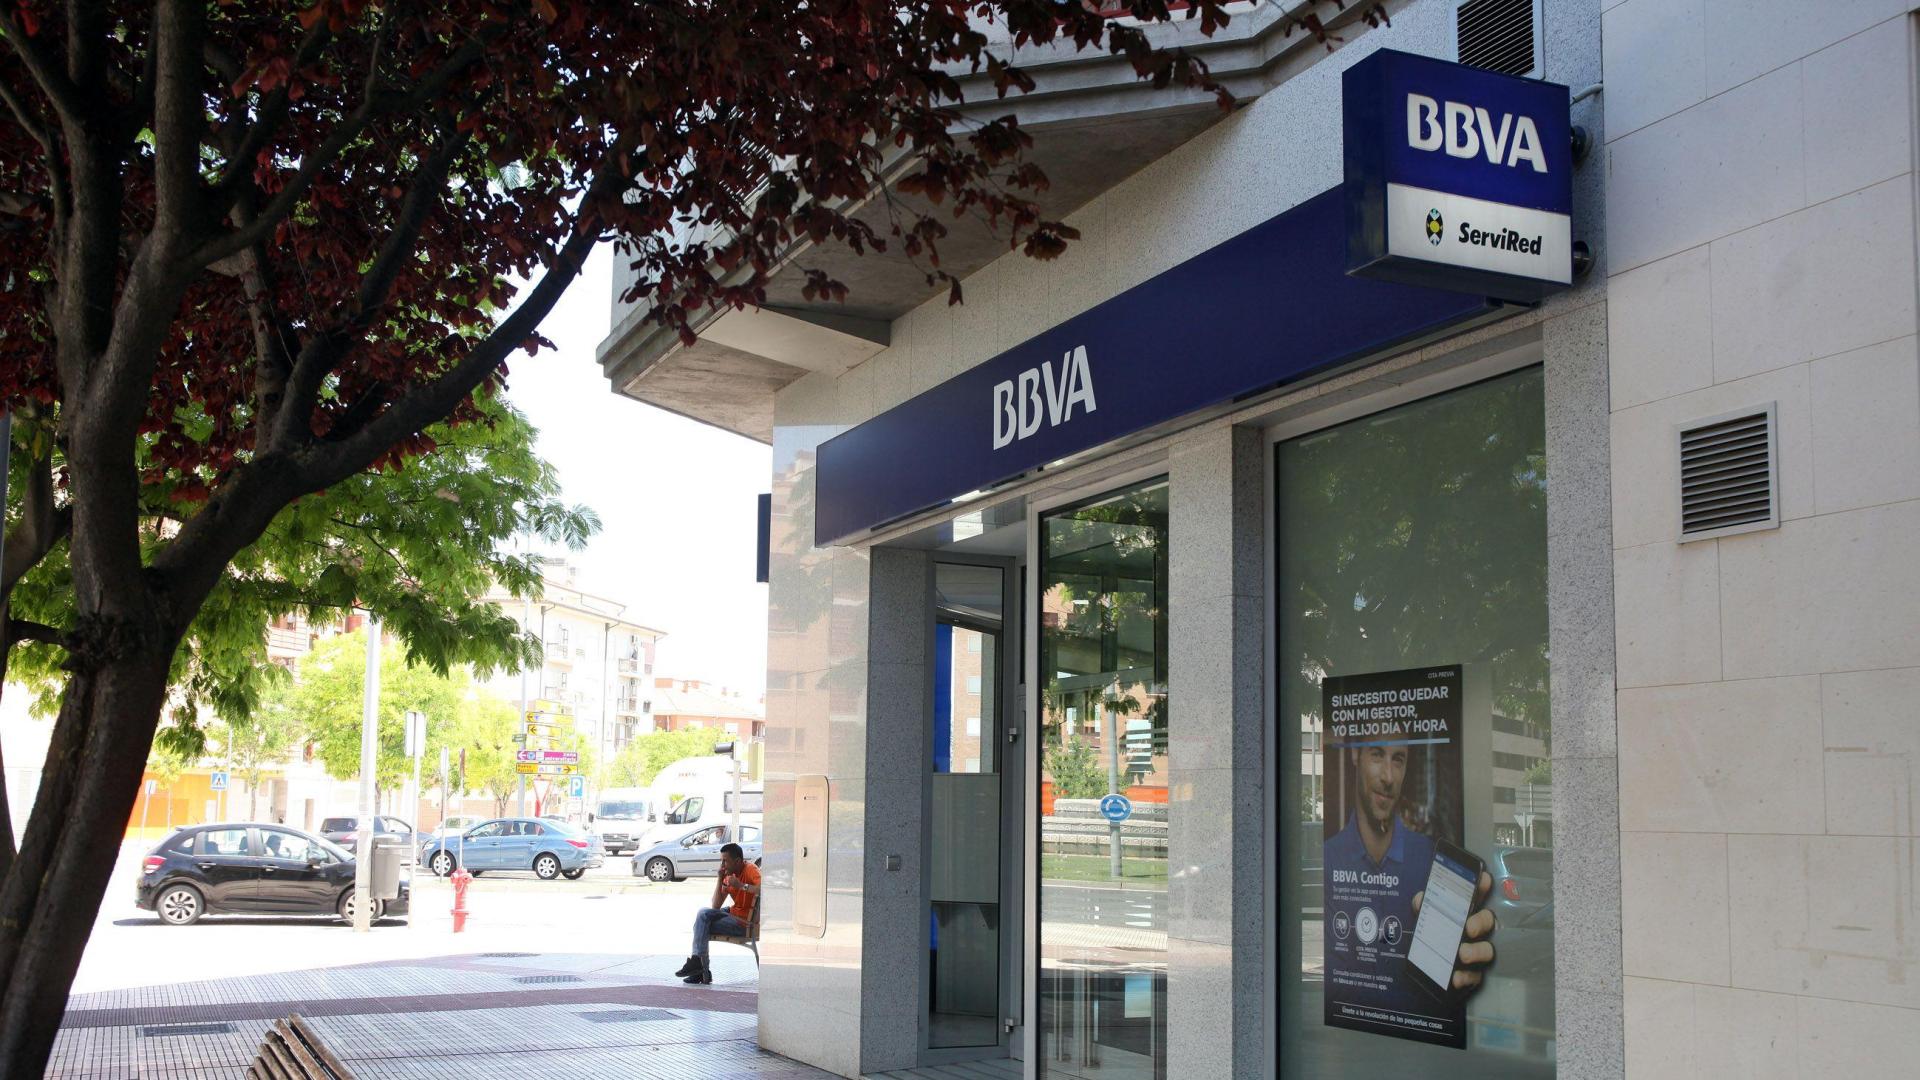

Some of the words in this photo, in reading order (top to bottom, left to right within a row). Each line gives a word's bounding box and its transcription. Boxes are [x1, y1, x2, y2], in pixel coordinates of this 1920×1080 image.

[1407, 93, 1548, 173] BBVA
[1458, 222, 1542, 256] ServiRed
[993, 345, 1097, 450] BBVA
[1332, 696, 1342, 708] SI
[1344, 690, 1397, 706] NECESITO
[1400, 686, 1448, 702] QUEDAR
[1332, 710, 1354, 722] CON
[1356, 709, 1368, 720] MI
[1370, 705, 1418, 719] GESTOR,
[1332, 725, 1346, 737] YO
[1348, 722, 1380, 736] ELIJO
[1382, 719, 1401, 734] DÍA
[1402, 720, 1412, 733] Y
[1414, 718, 1448, 732] HORA
[572, 778, 582, 796] P
[1333, 870, 1358, 883] BBVA
[1360, 872, 1399, 888] Contigo
